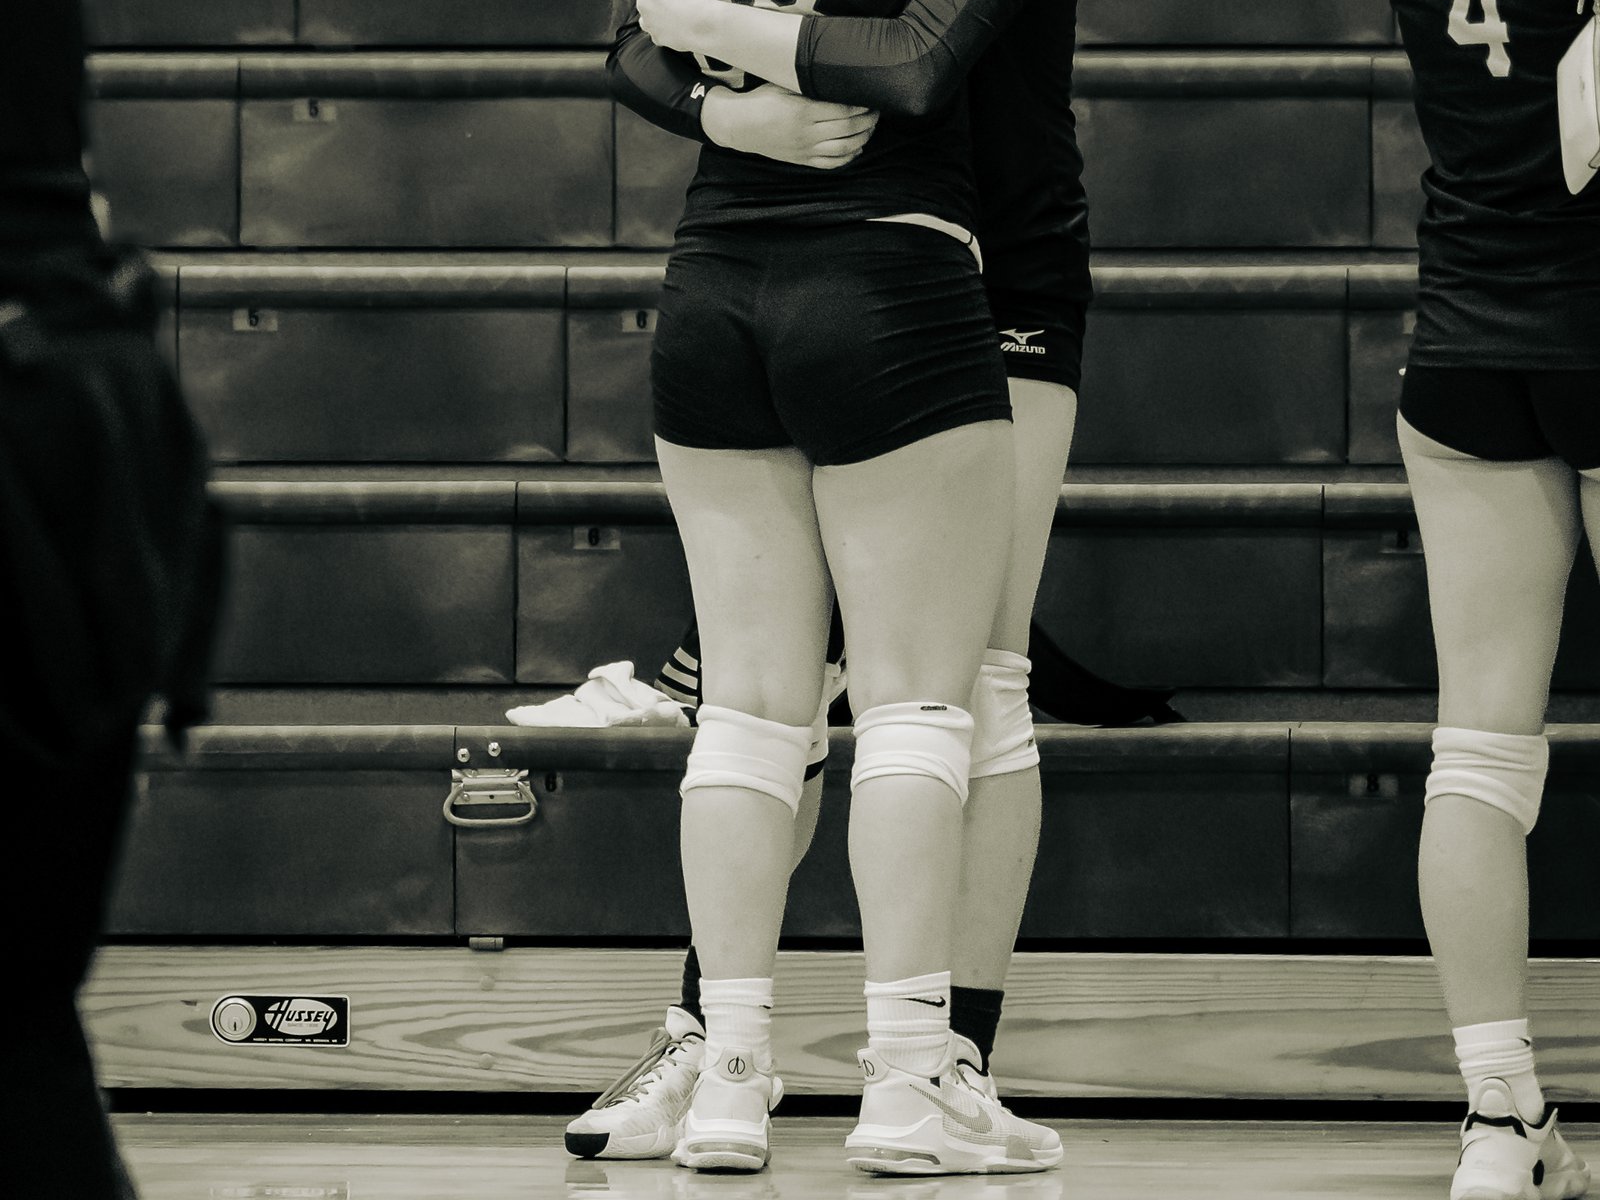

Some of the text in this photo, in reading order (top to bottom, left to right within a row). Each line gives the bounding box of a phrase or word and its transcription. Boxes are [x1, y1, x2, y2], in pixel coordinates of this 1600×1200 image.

[248, 309, 259, 327] 5
[1000, 341, 1046, 354] MIZUNO
[1367, 774, 1378, 792] 8
